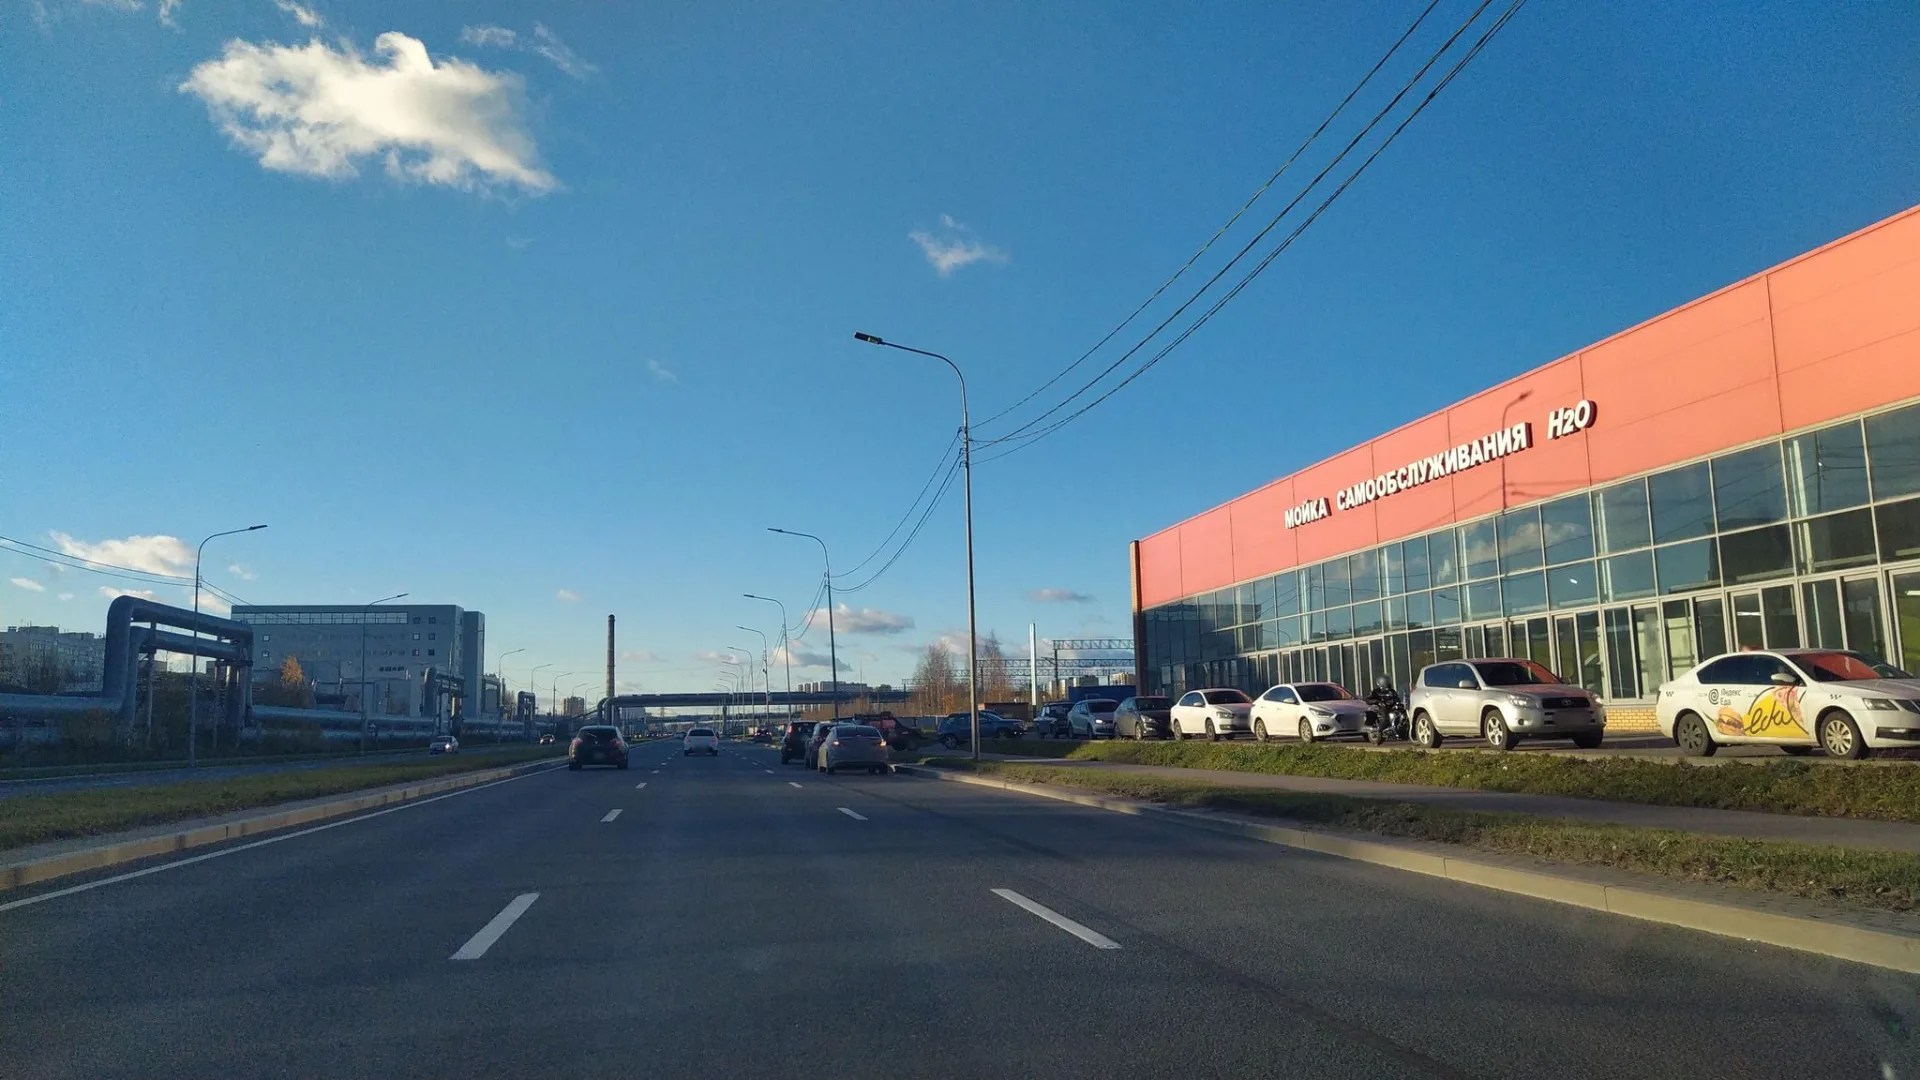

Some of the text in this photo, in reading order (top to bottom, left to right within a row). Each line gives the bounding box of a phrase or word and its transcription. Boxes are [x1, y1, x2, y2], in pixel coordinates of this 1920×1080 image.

[1284, 398, 1596, 529] МОЙКА САМООБСЛУЖИВАНИЯ H2O
[1720, 688, 1742, 697] Яндекс
